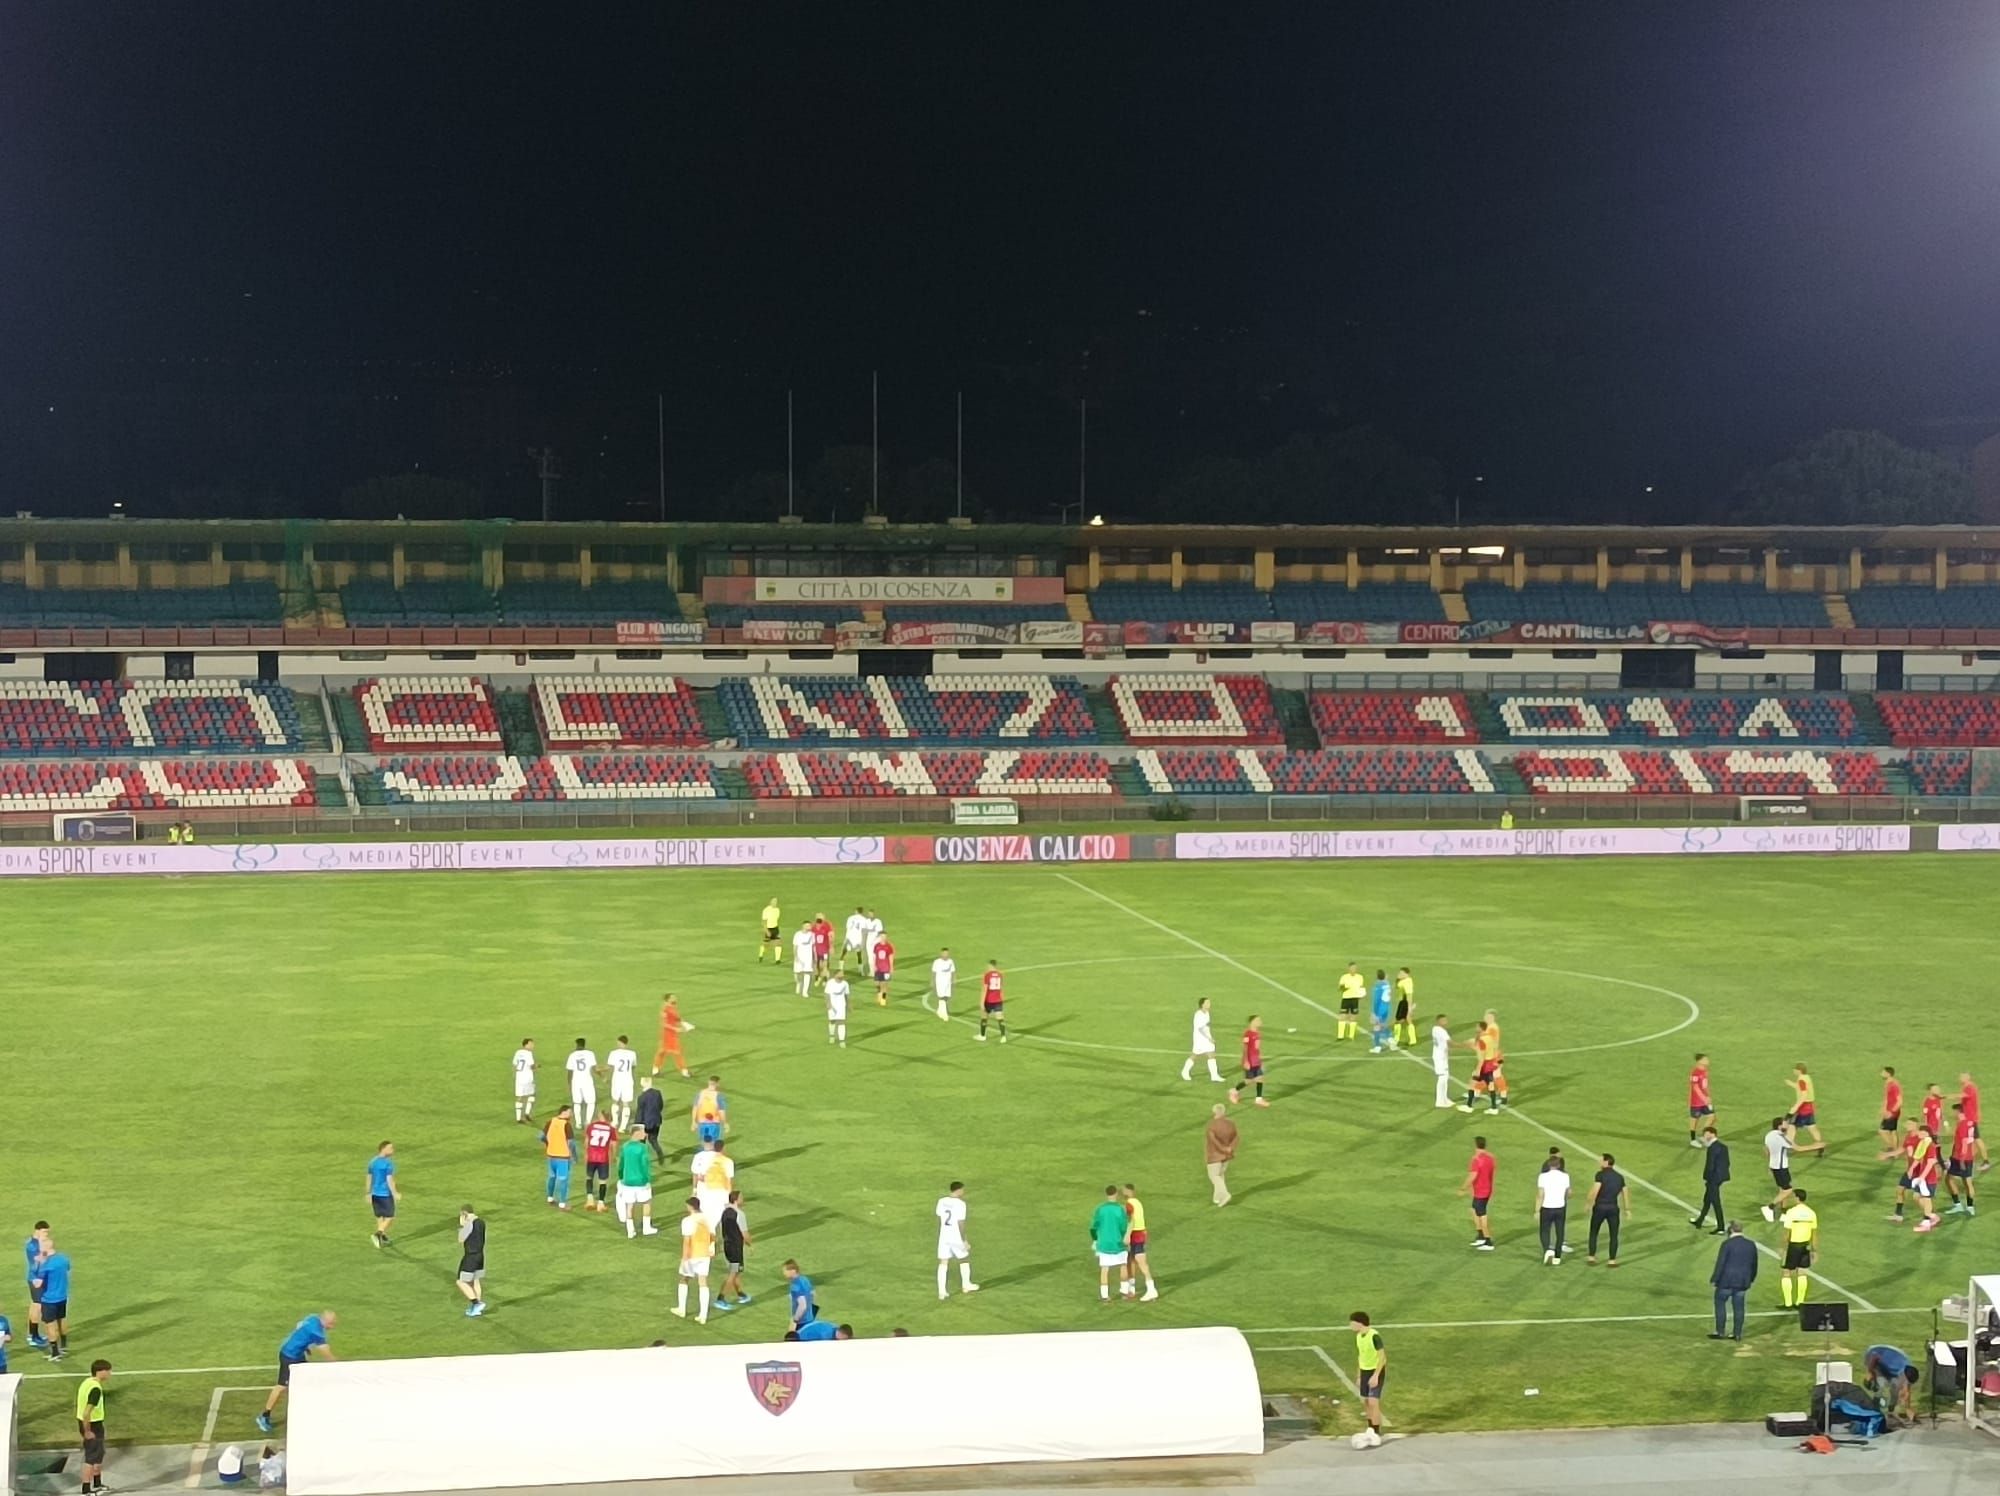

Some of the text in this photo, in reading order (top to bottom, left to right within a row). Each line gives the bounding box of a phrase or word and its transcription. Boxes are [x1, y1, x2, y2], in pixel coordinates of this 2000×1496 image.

[798, 579, 972, 599] CITTÀ DI COSENZA
[616, 622, 645, 635] CLUB
[1183, 622, 1235, 636] LUPI
[1404, 623, 1460, 641] CENTRO
[1520, 622, 1645, 640] CANTINELLA
[932, 635, 977, 645] COSENZA
[1235, 832, 1396, 857] MEDIA SPORT EVENT
[1460, 830, 1617, 855] MEDIA SPORT EVENT
[1782, 833, 1830, 846] MEDIA
[1835, 826, 1883, 851] SPORT
[349, 843, 525, 869] MEDIA SPORT EVENT
[597, 840, 767, 866] MEDIA SPORT EVENT
[935, 835, 1115, 863] COSENZA CALCIO
[40, 847, 95, 873] SPORT
[103, 852, 158, 867] EVENT
[617, 1058, 631, 1073] 21
[943, 1209, 952, 1226] 2
